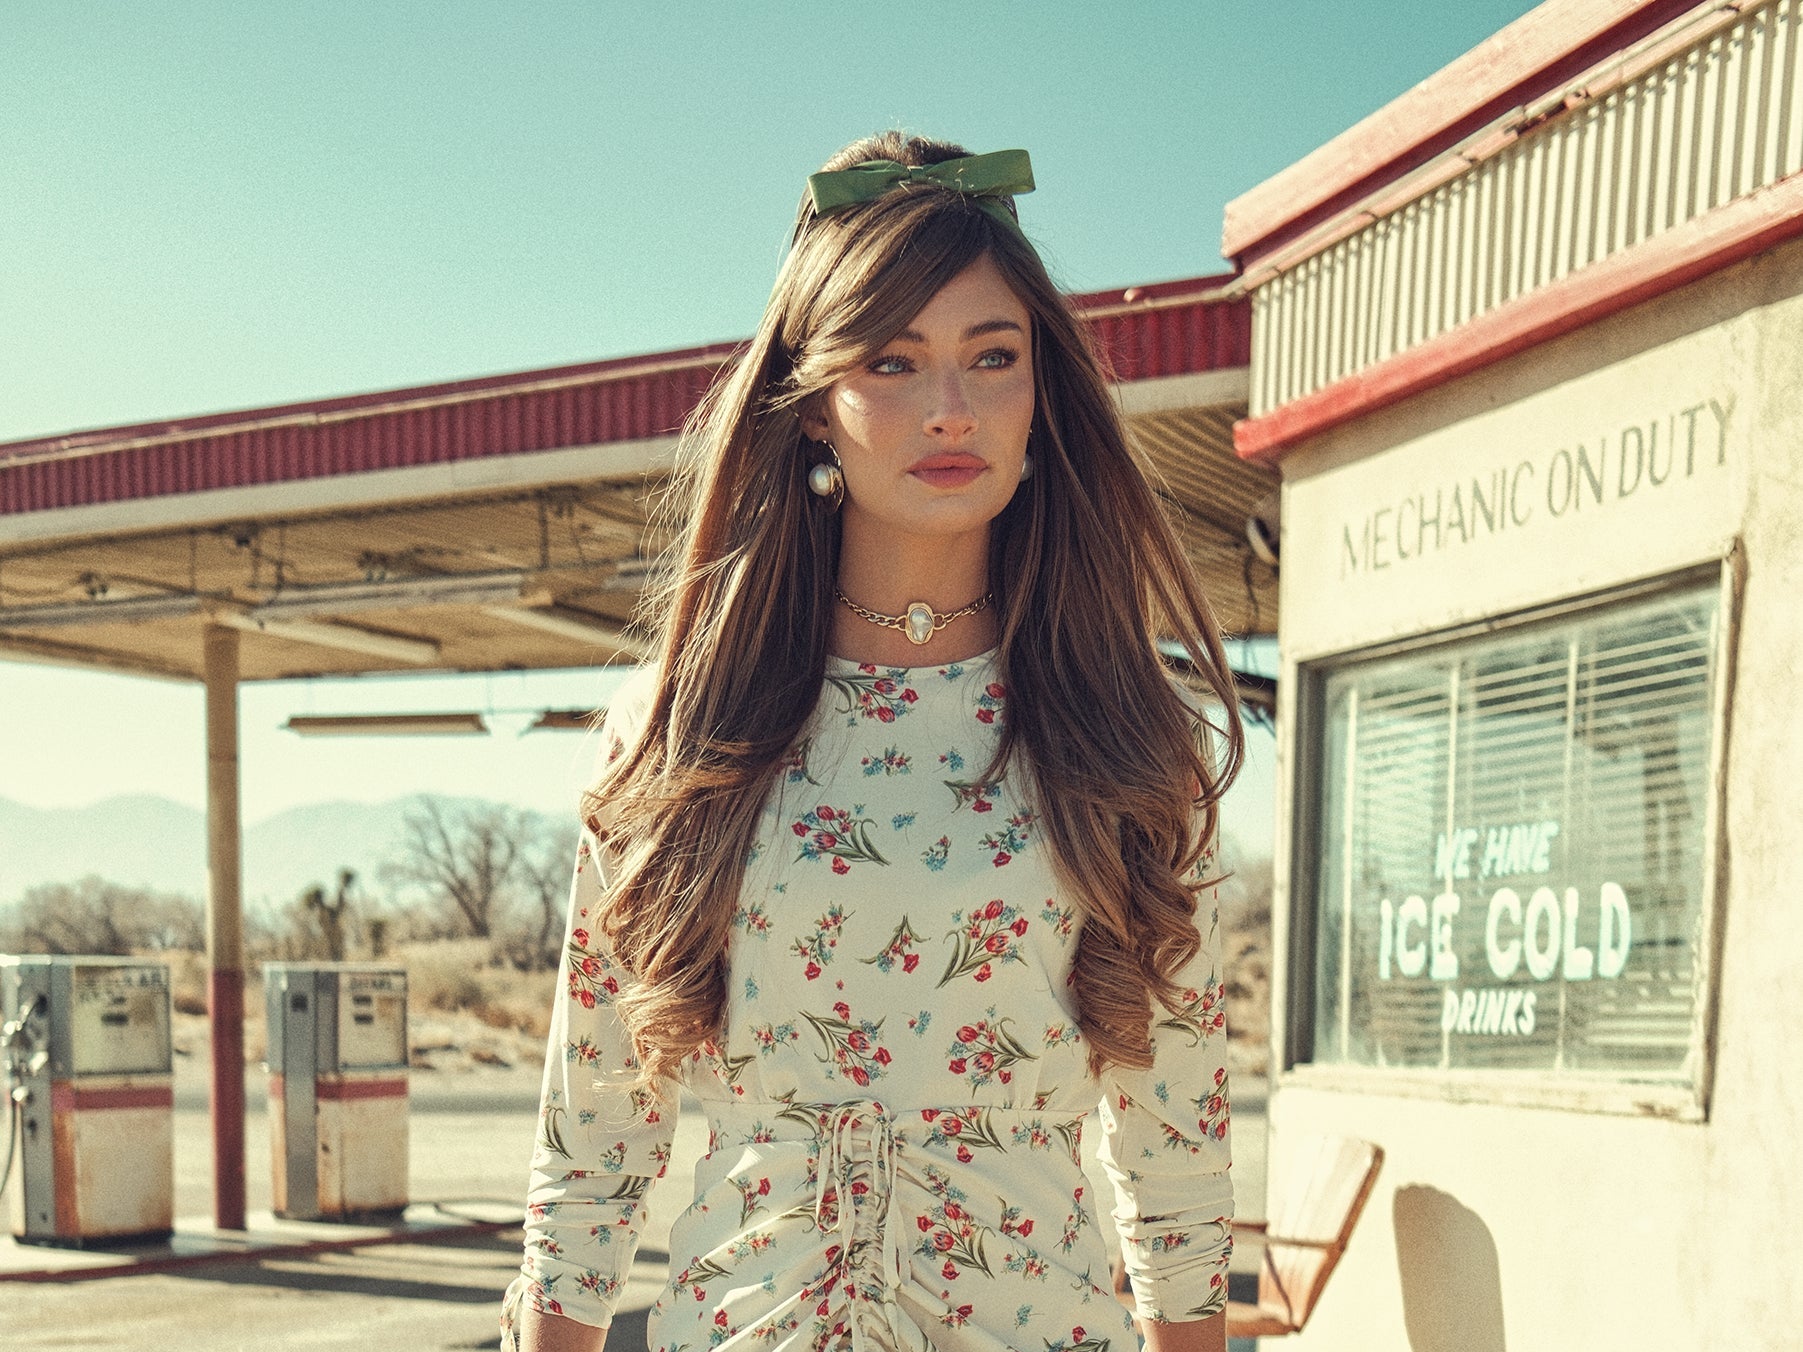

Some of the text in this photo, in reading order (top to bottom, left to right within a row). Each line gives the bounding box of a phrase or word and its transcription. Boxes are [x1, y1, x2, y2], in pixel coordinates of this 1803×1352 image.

[1340, 394, 1737, 581] MECHANIC ON DUTY
[1435, 820, 1559, 879] WE HAVE
[1379, 881, 1632, 981] ICE COLD
[1441, 989, 1537, 1036] DRINKS
